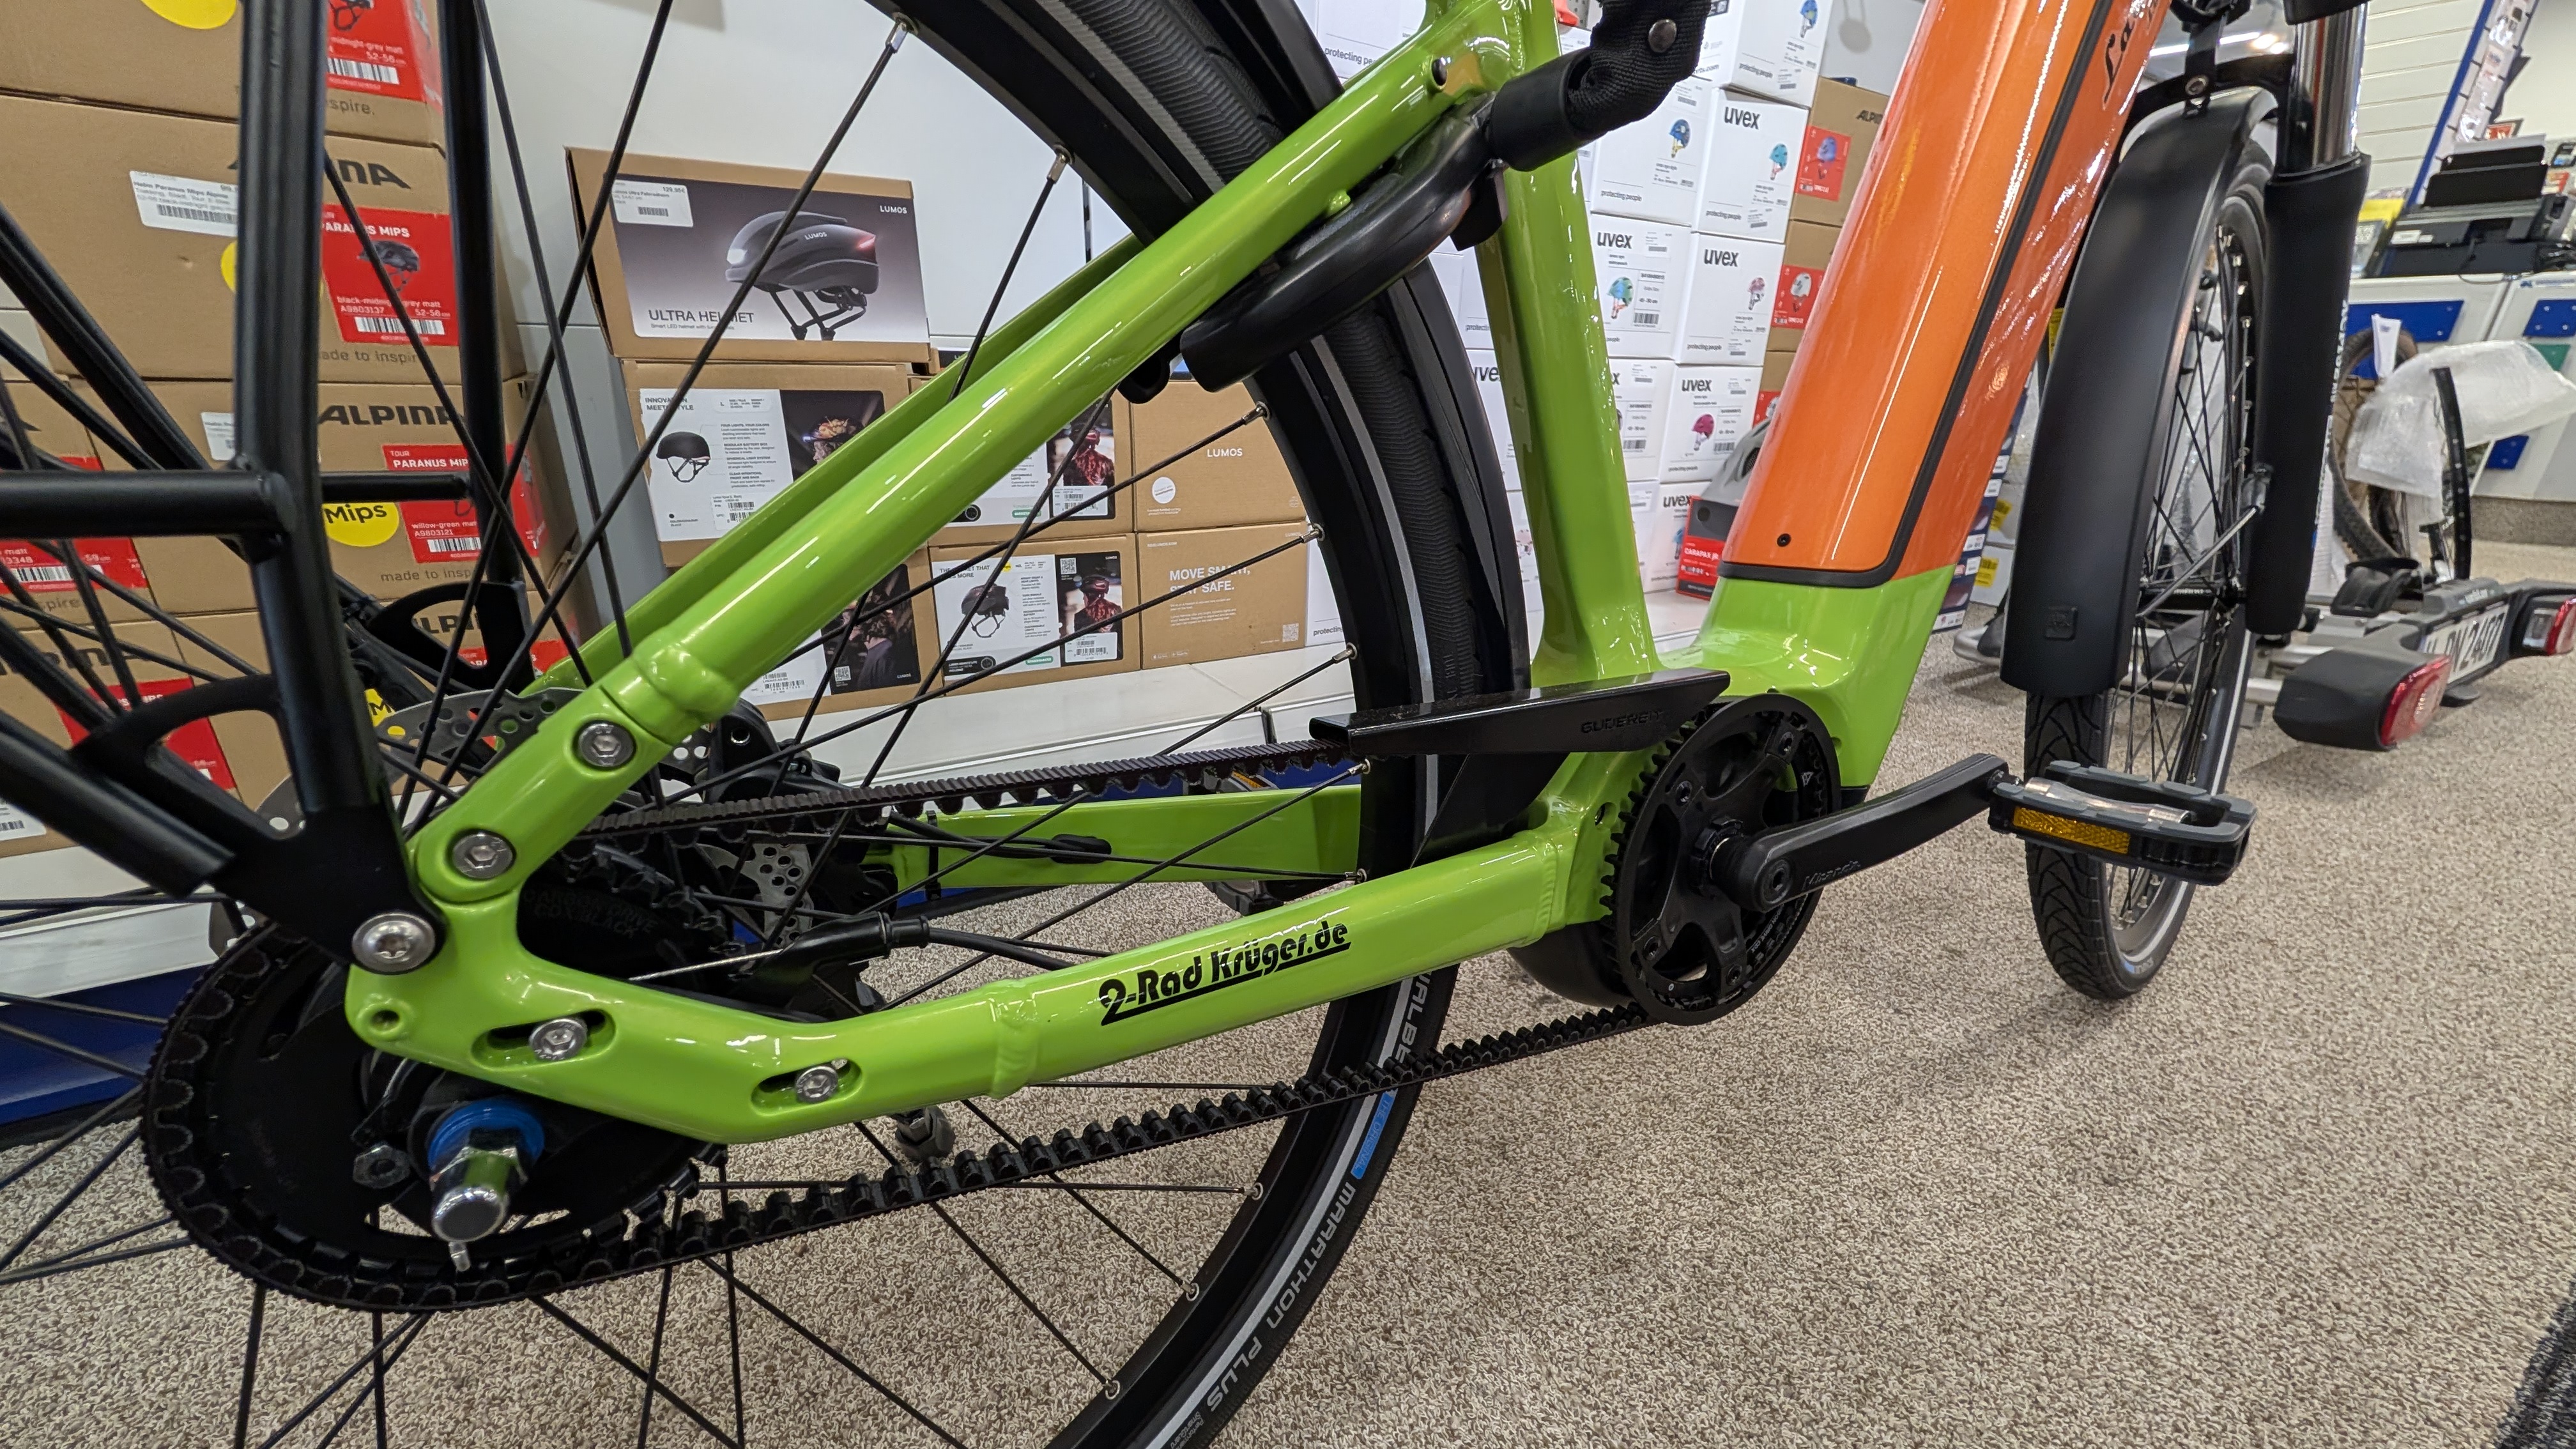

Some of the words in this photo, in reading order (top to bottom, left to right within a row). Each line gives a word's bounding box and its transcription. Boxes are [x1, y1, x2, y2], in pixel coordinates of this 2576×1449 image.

[328, 98, 375, 116] spire.
[1724, 107, 1761, 130] uvex
[879, 205, 908, 215] LUMOS
[378, 226, 411, 238] MIPS
[804, 231, 828, 240] LUMOS
[1597, 231, 1634, 249] uvex
[1703, 249, 1739, 267] uvex
[648, 309, 696, 322] ULTRA
[698, 310, 755, 323] HELET
[355, 349, 370, 362] to
[375, 349, 416, 365] inspir
[1474, 366, 1501, 382] ve
[1682, 379, 1713, 392] uvex
[1207, 448, 1243, 457] LUMOS
[393, 459, 447, 468] PARANUS
[449, 458, 470, 467] MIP
[323, 503, 387, 524] Mips
[381, 570, 420, 582] made
[425, 569, 438, 579] to
[444, 567, 471, 581] insp
[1170, 567, 1205, 581] MOVE
[1202, 580, 1234, 593] SAFE.
[1099, 954, 1203, 1026] 2-Rad
[1211, 921, 1349, 983] Krüger.de
[1395, 970, 1432, 1064] ALBE
[1266, 1181, 1356, 1329] MARATHON
[1207, 1336, 1264, 1412] PLUS
